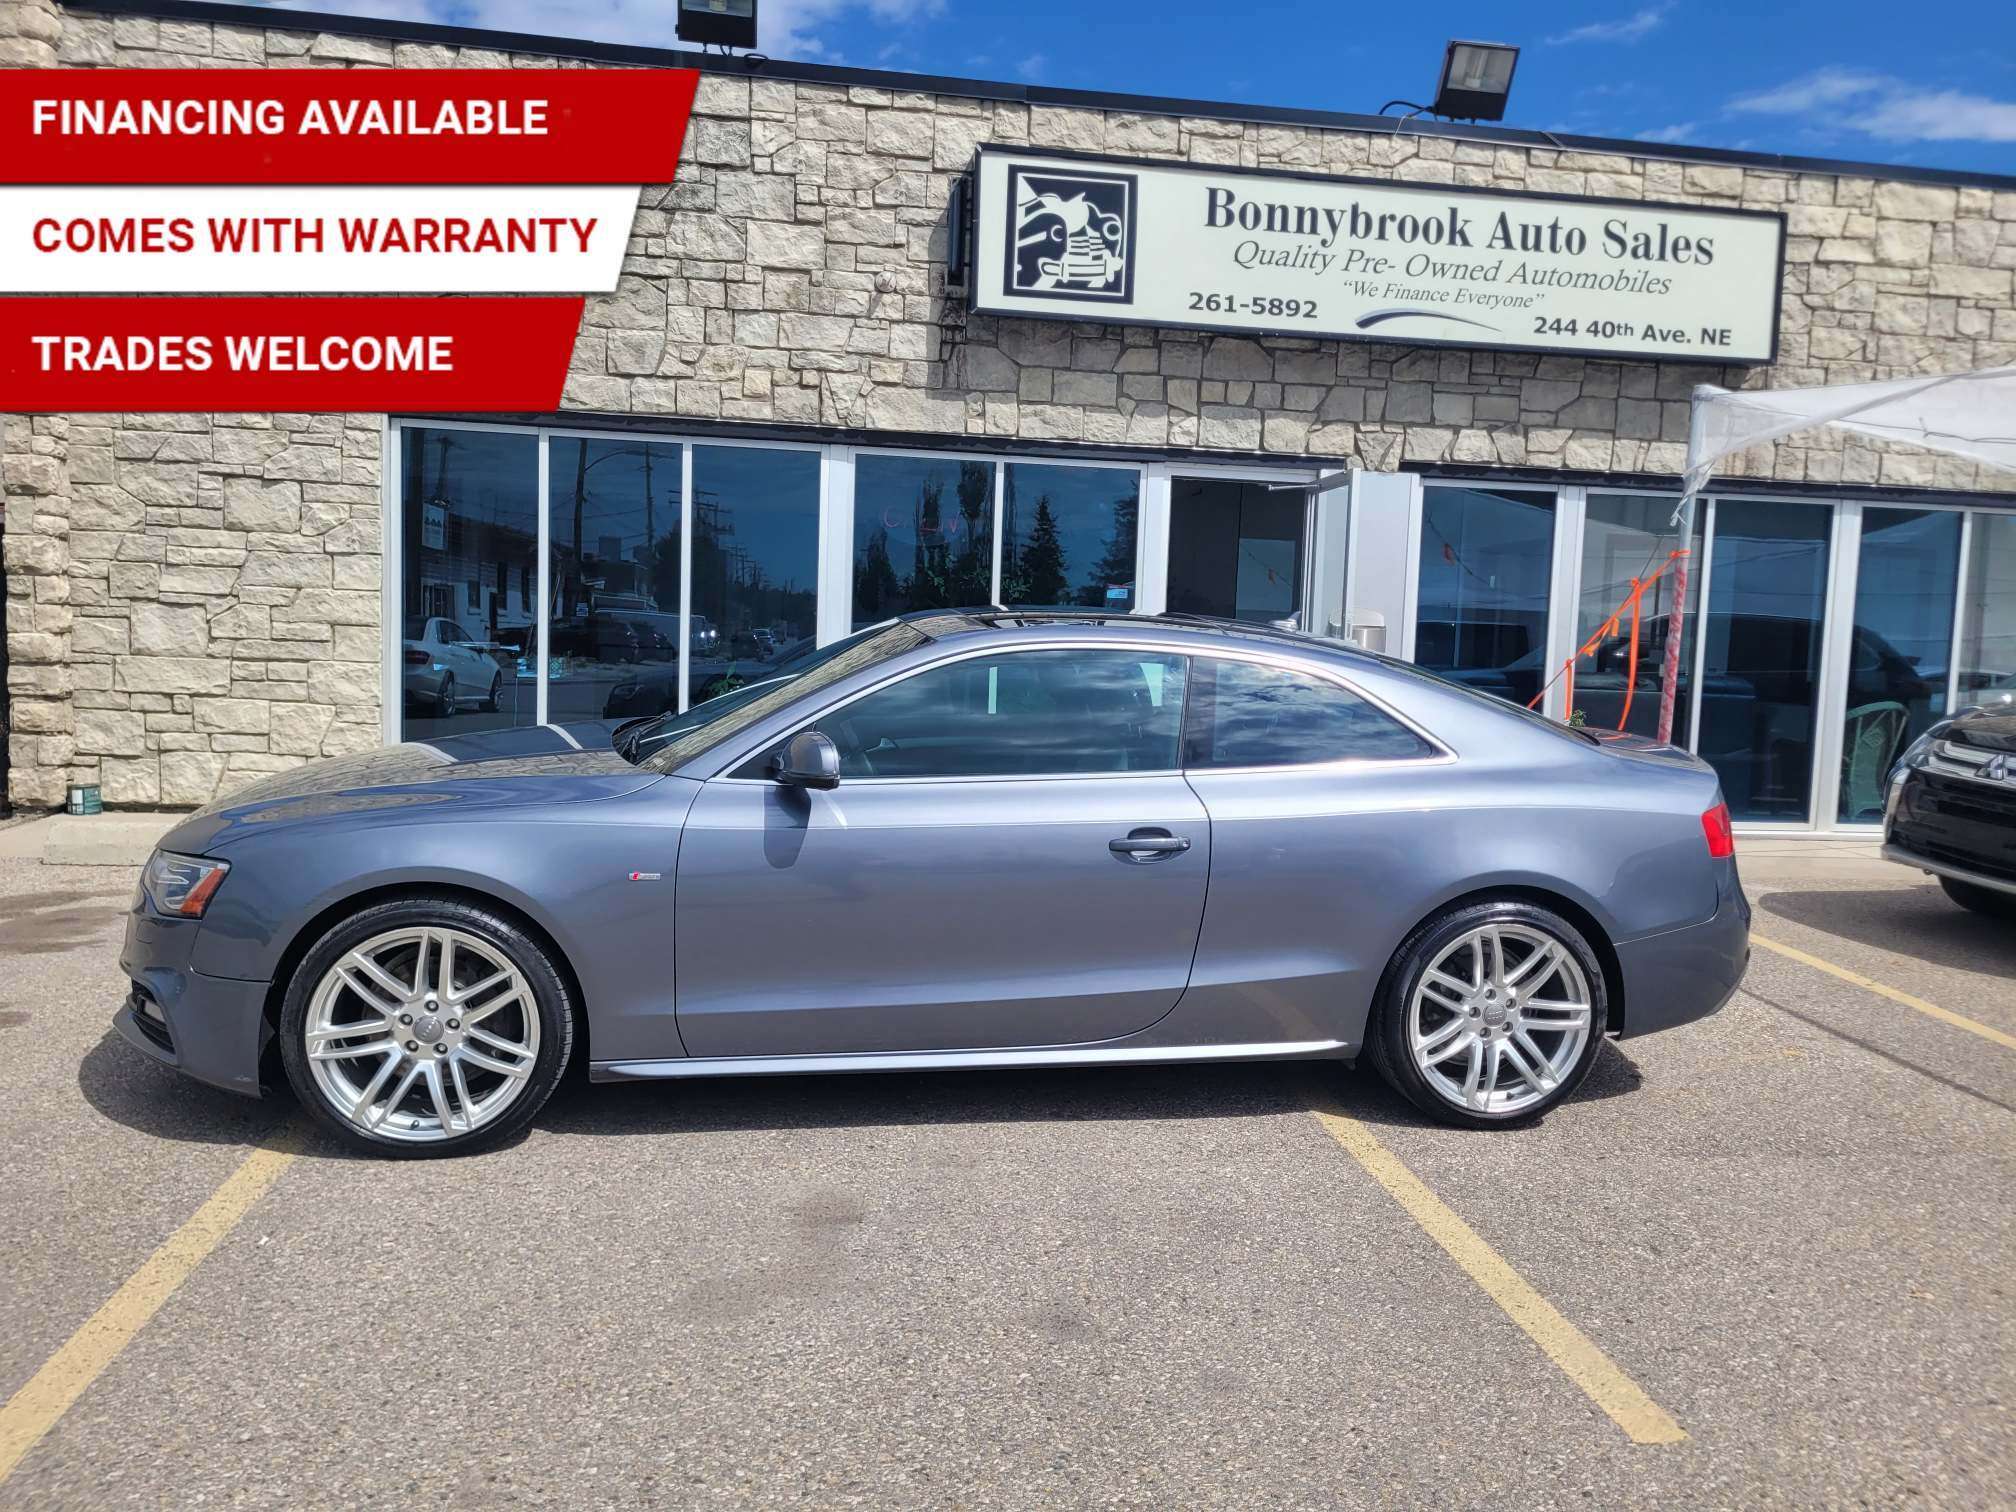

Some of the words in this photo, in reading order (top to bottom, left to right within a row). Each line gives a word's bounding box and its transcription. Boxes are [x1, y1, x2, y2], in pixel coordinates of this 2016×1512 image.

[1204, 187, 1474, 248] Bonnybrook
[1486, 211, 1587, 255] Auto
[1602, 219, 1714, 265] Sales
[1233, 240, 1336, 275] Quality
[1341, 248, 1396, 274] Pre-
[1405, 253, 1503, 282] Owned
[1506, 261, 1672, 295] Automobiles
[1188, 292, 1318, 319] 261-5892
[1382, 283, 1449, 302] Finance
[1533, 316, 1578, 337] 244
[1586, 320, 1634, 339] 40th
[1641, 324, 1692, 344] Ave.
[1700, 328, 1732, 346] NE
